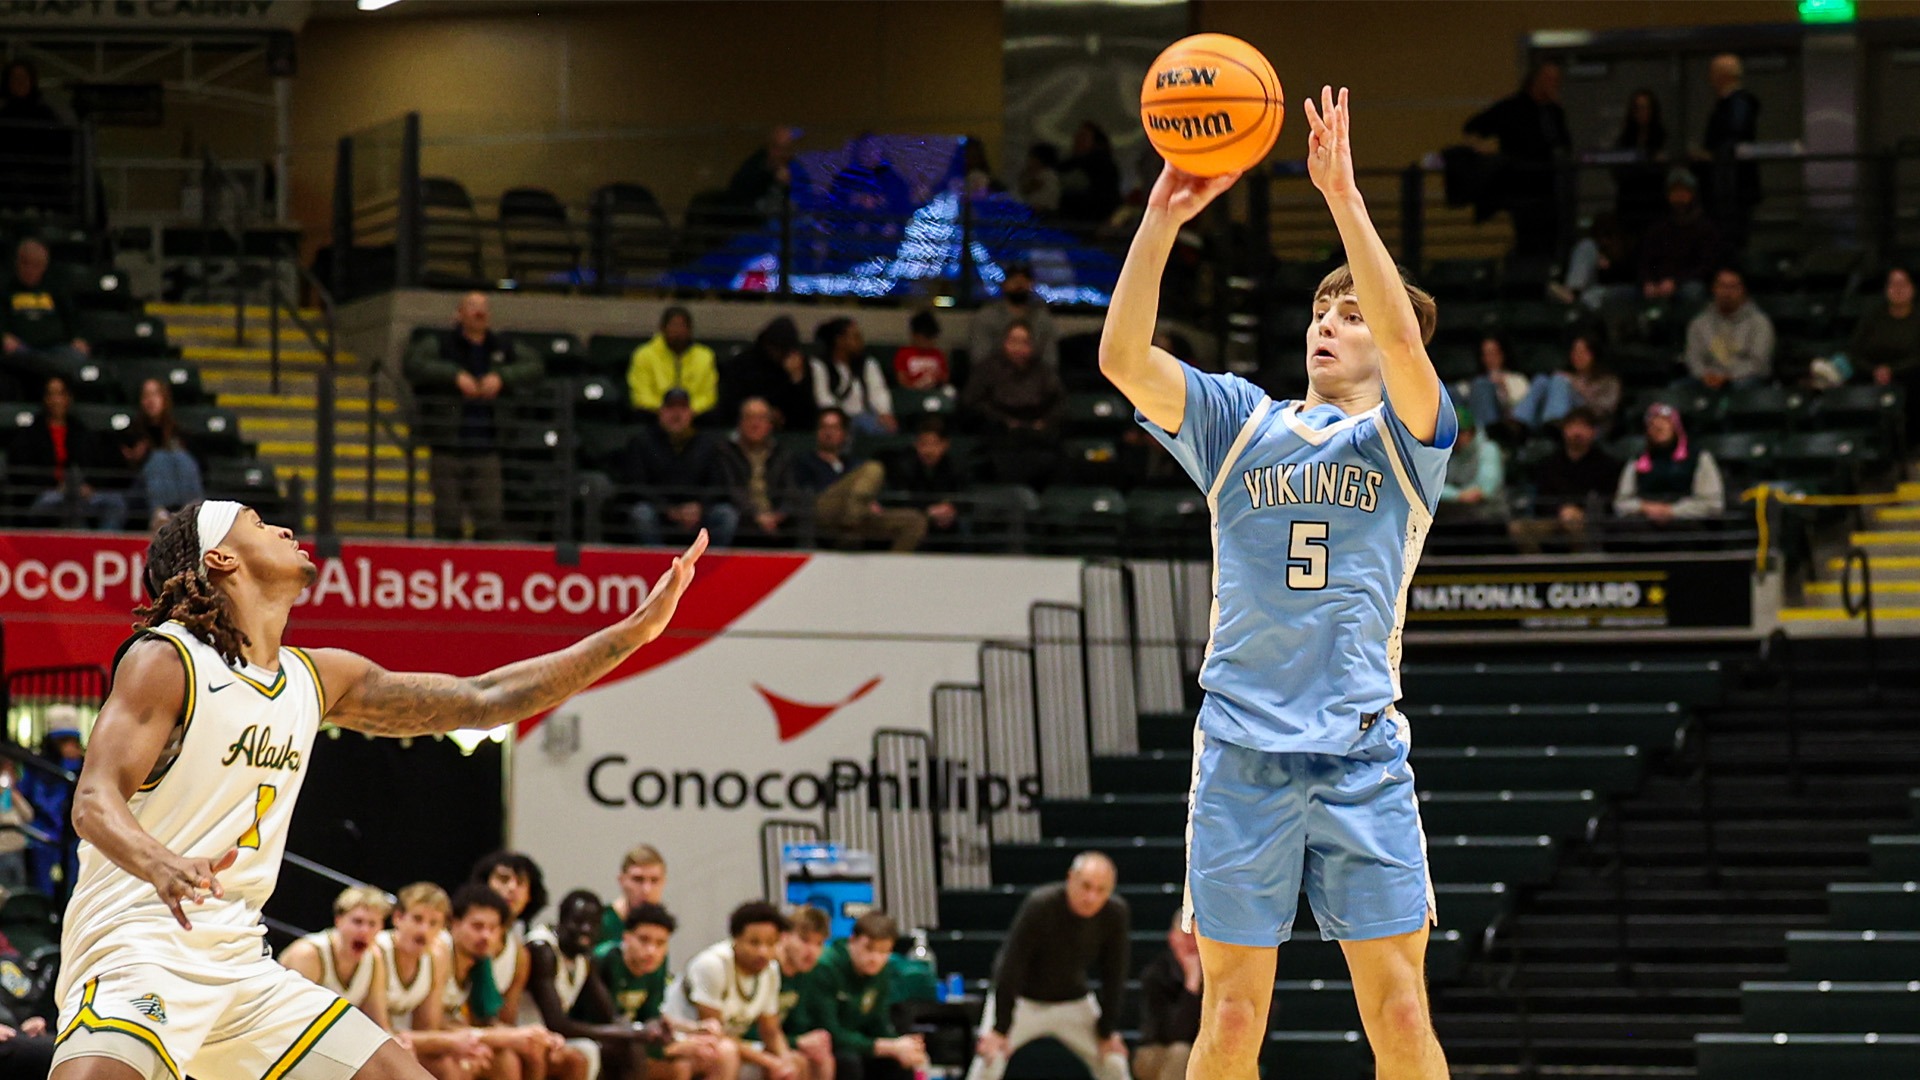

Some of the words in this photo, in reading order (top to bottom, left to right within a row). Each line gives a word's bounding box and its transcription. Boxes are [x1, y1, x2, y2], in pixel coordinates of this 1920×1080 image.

[1147, 109, 1234, 141] Wilson
[1243, 461, 1384, 513] VIKINGS
[1285, 520, 1330, 591] 5
[1412, 583, 1544, 611] NATIONAL
[1546, 581, 1642, 608] GUARD
[221, 724, 300, 772] Alask
[586, 753, 1042, 826] ConocoPhillips
[236, 783, 277, 851] 1
